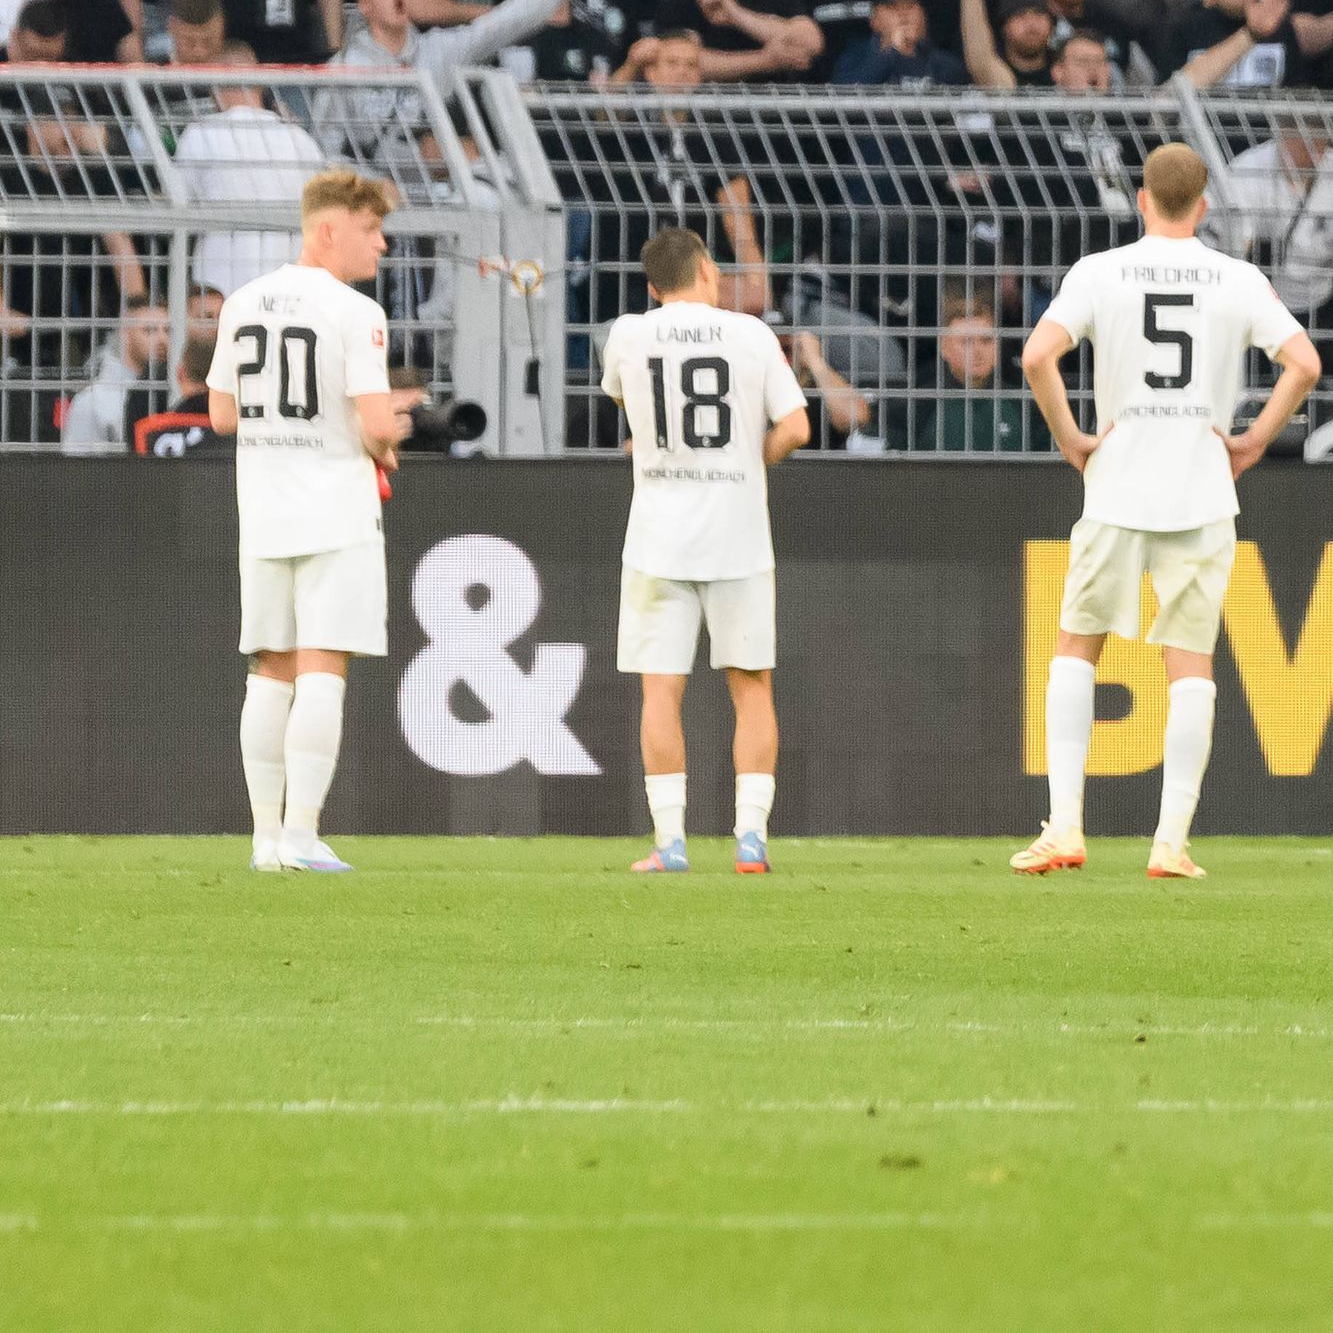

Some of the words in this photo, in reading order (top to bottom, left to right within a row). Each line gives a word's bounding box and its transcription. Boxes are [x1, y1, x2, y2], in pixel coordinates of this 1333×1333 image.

[1121, 267, 1220, 285] FRIEDRICH
[233, 324, 318, 420] 20
[656, 325, 723, 343] LAINER
[1143, 293, 1194, 389] 5
[647, 356, 731, 449] 18
[398, 534, 603, 776] &
